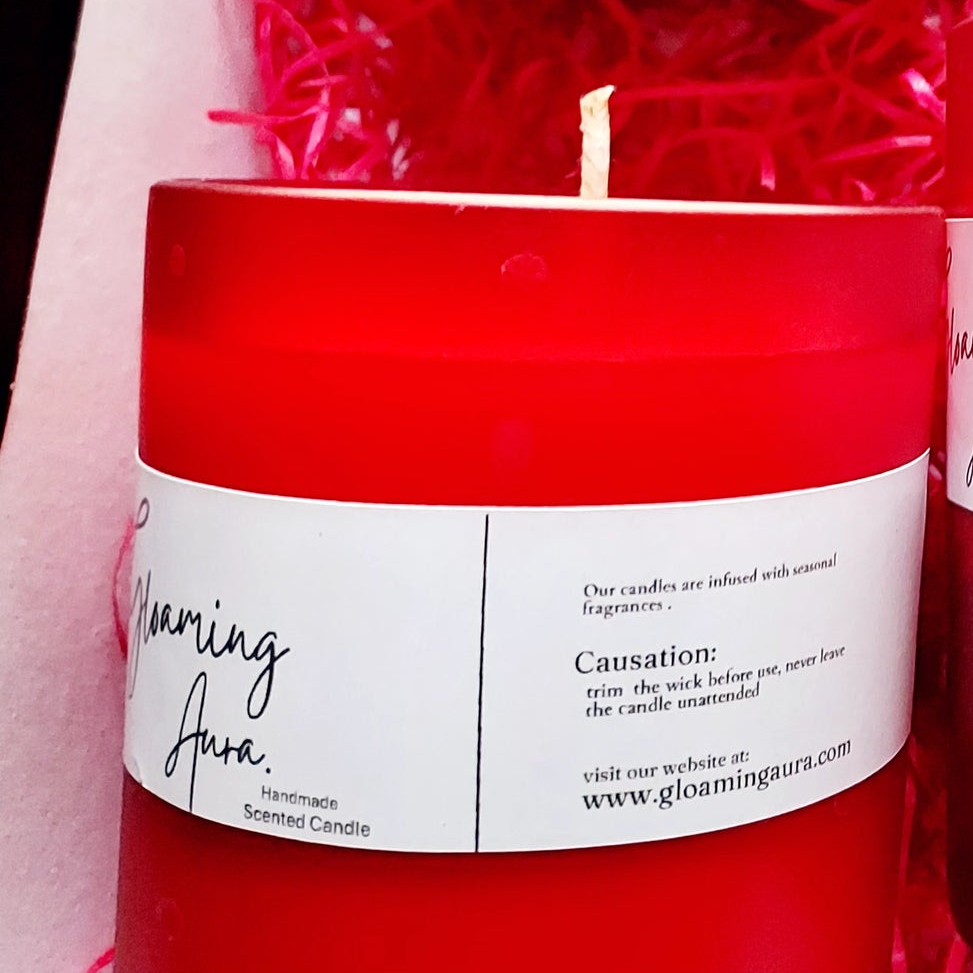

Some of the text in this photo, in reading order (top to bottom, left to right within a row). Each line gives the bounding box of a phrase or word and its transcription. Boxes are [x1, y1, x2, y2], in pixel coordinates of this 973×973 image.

[584, 552, 837, 598] Our candles are infused with seasonal
[582, 599, 663, 619] fragrances
[574, 644, 717, 674] Causation:
[587, 645, 846, 699] trim the wick before use, never leave
[586, 681, 760, 717] the candle unattended
[165, 671, 272, 813] Aura.
[582, 739, 851, 810] www.gloamingaura.com
[583, 750, 750, 783] visit our website at:
[261, 784, 339, 810] Handmade
[244, 803, 371, 838] Scented Candle
